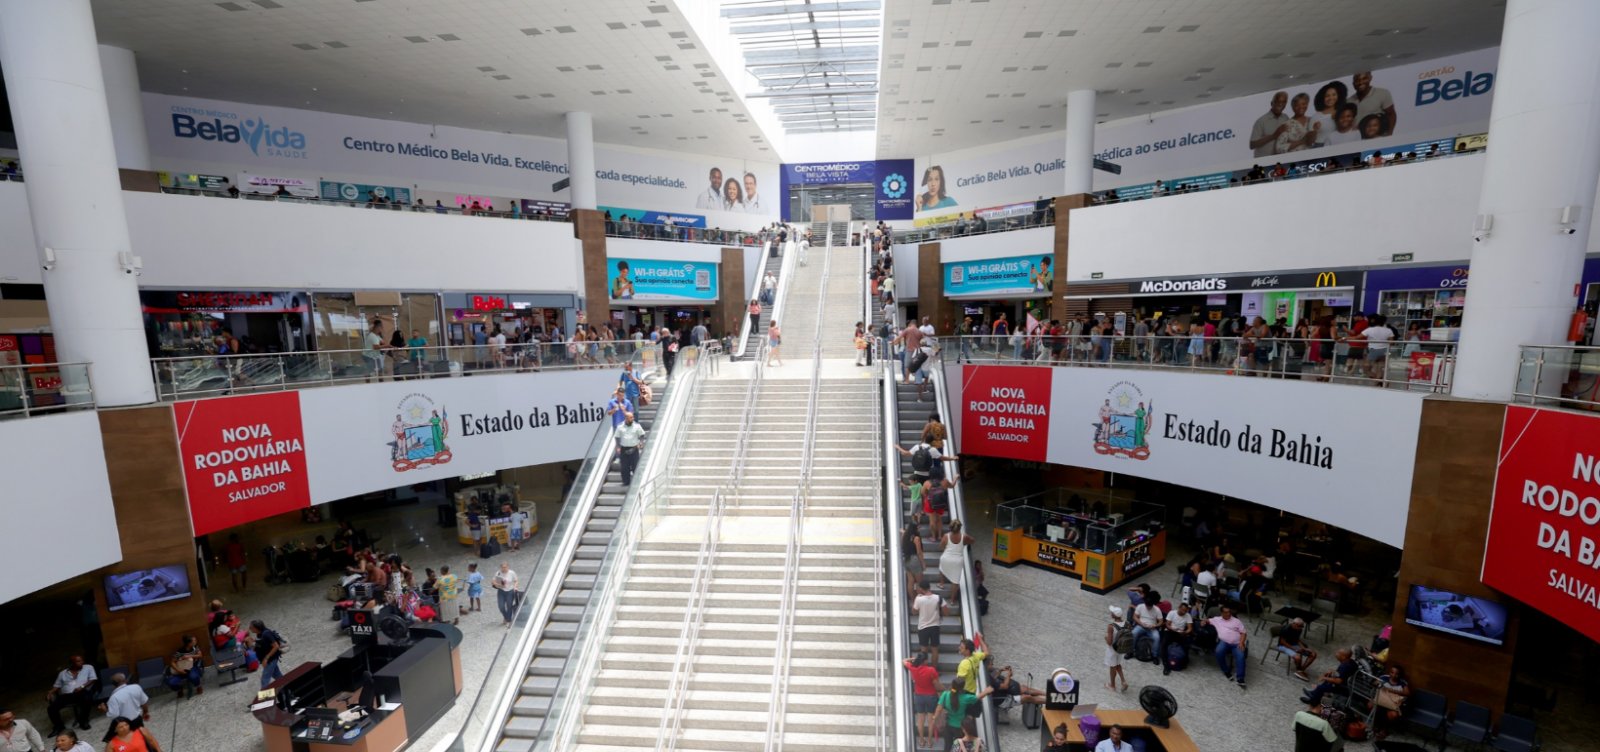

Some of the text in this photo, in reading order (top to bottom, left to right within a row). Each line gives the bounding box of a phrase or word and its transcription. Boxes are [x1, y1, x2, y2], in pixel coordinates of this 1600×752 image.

[1418, 66, 1456, 80] CARTÃO
[1415, 71, 1494, 107] Bela
[170, 105, 238, 120] CENTRO MÉDICO
[343, 136, 395, 154] Centro
[397, 142, 448, 160] Médico
[451, 148, 479, 163] Bela
[481, 152, 513, 168] Vida.
[595, 169, 620, 181] cada
[622, 172, 688, 189] especialidade.
[956, 174, 986, 188] Cartão
[986, 169, 1007, 182] Bela
[1008, 164, 1032, 177] Vida.
[1135, 142, 1151, 154] ao
[1153, 137, 1176, 151] seu
[1178, 128, 1236, 147] alcance.
[656, 267, 685, 278] GRÁTIS
[988, 261, 1018, 273] GRÁTIS
[1140, 278, 1227, 293] McDonald's
[991, 387, 1025, 399] NOVA
[970, 401, 1046, 416] RODOVIÁRIA
[460, 400, 605, 437] Estado da Bahia
[980, 416, 1035, 430] DA BAHIA
[221, 423, 272, 444] NOVA
[987, 431, 1029, 443] SALVADOR
[1163, 413, 1333, 470] Estado da Bahia
[194, 438, 303, 470] RODOVIÁRIA
[213, 459, 292, 488] DA BAHIA
[228, 481, 286, 503] SALVADOR
[1522, 479, 1600, 526] RODO
[1537, 521, 1571, 559] DA
[1038, 543, 1076, 560] LIGHT
[1038, 552, 1054, 561] RENT
[1061, 559, 1074, 567] CAR
[351, 624, 373, 633] TÁXI
[1050, 692, 1076, 704] TAXI
